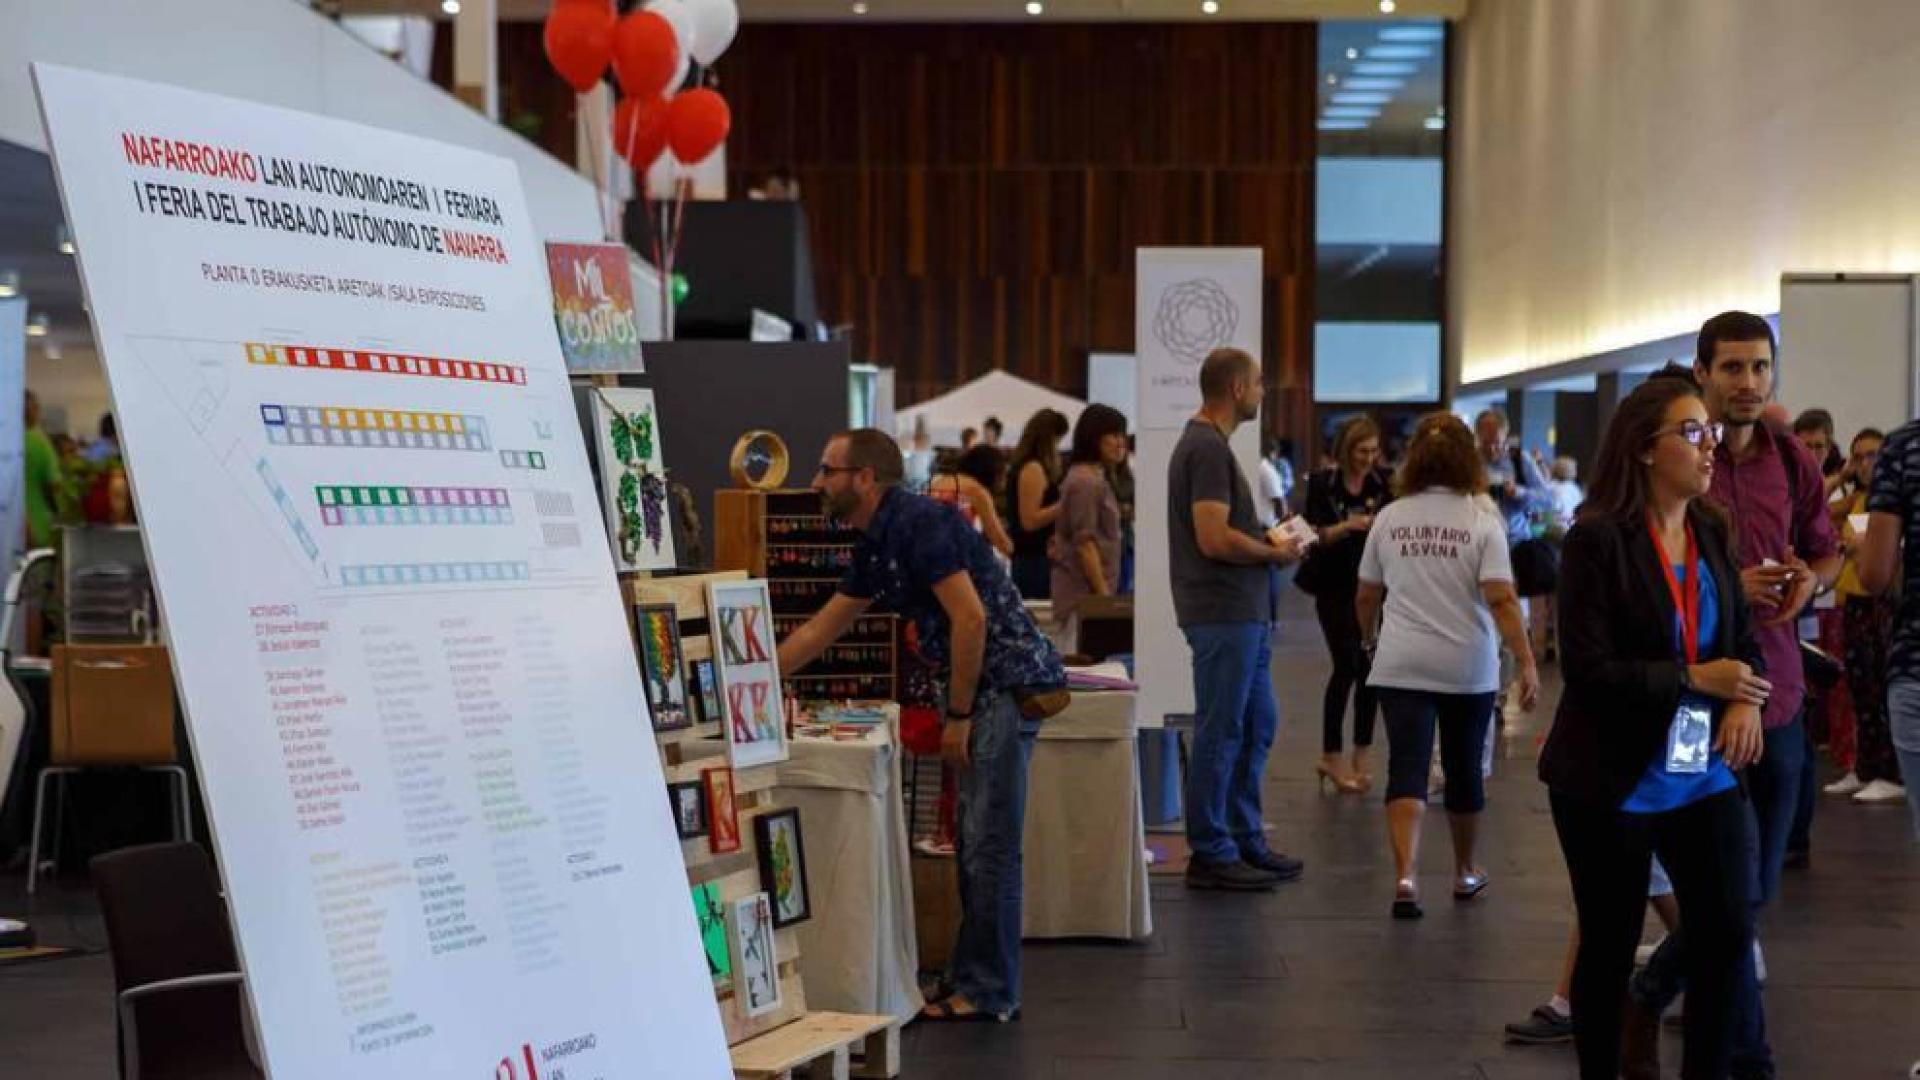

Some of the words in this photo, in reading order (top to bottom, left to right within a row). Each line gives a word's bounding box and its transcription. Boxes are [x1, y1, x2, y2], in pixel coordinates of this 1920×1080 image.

[122, 131, 257, 183] NAFARROAKO
[257, 155, 298, 189] LAN
[299, 162, 430, 212] AUTONOMOAREN
[444, 189, 504, 226] FERIARA
[133, 180, 144, 213] I
[145, 183, 207, 220] FERIA
[206, 190, 247, 226] DEL
[246, 197, 329, 237] TRABAJO
[332, 206, 420, 251] AUTÓNOMO
[420, 224, 444, 253] DE
[442, 229, 509, 265] NAVARRA
[201, 262, 249, 285] PLANTA
[261, 268, 337, 294] ERAKUSKETA
[336, 277, 388, 299] ARETOAK
[1390, 527, 1471, 544] VOLUNTARIO
